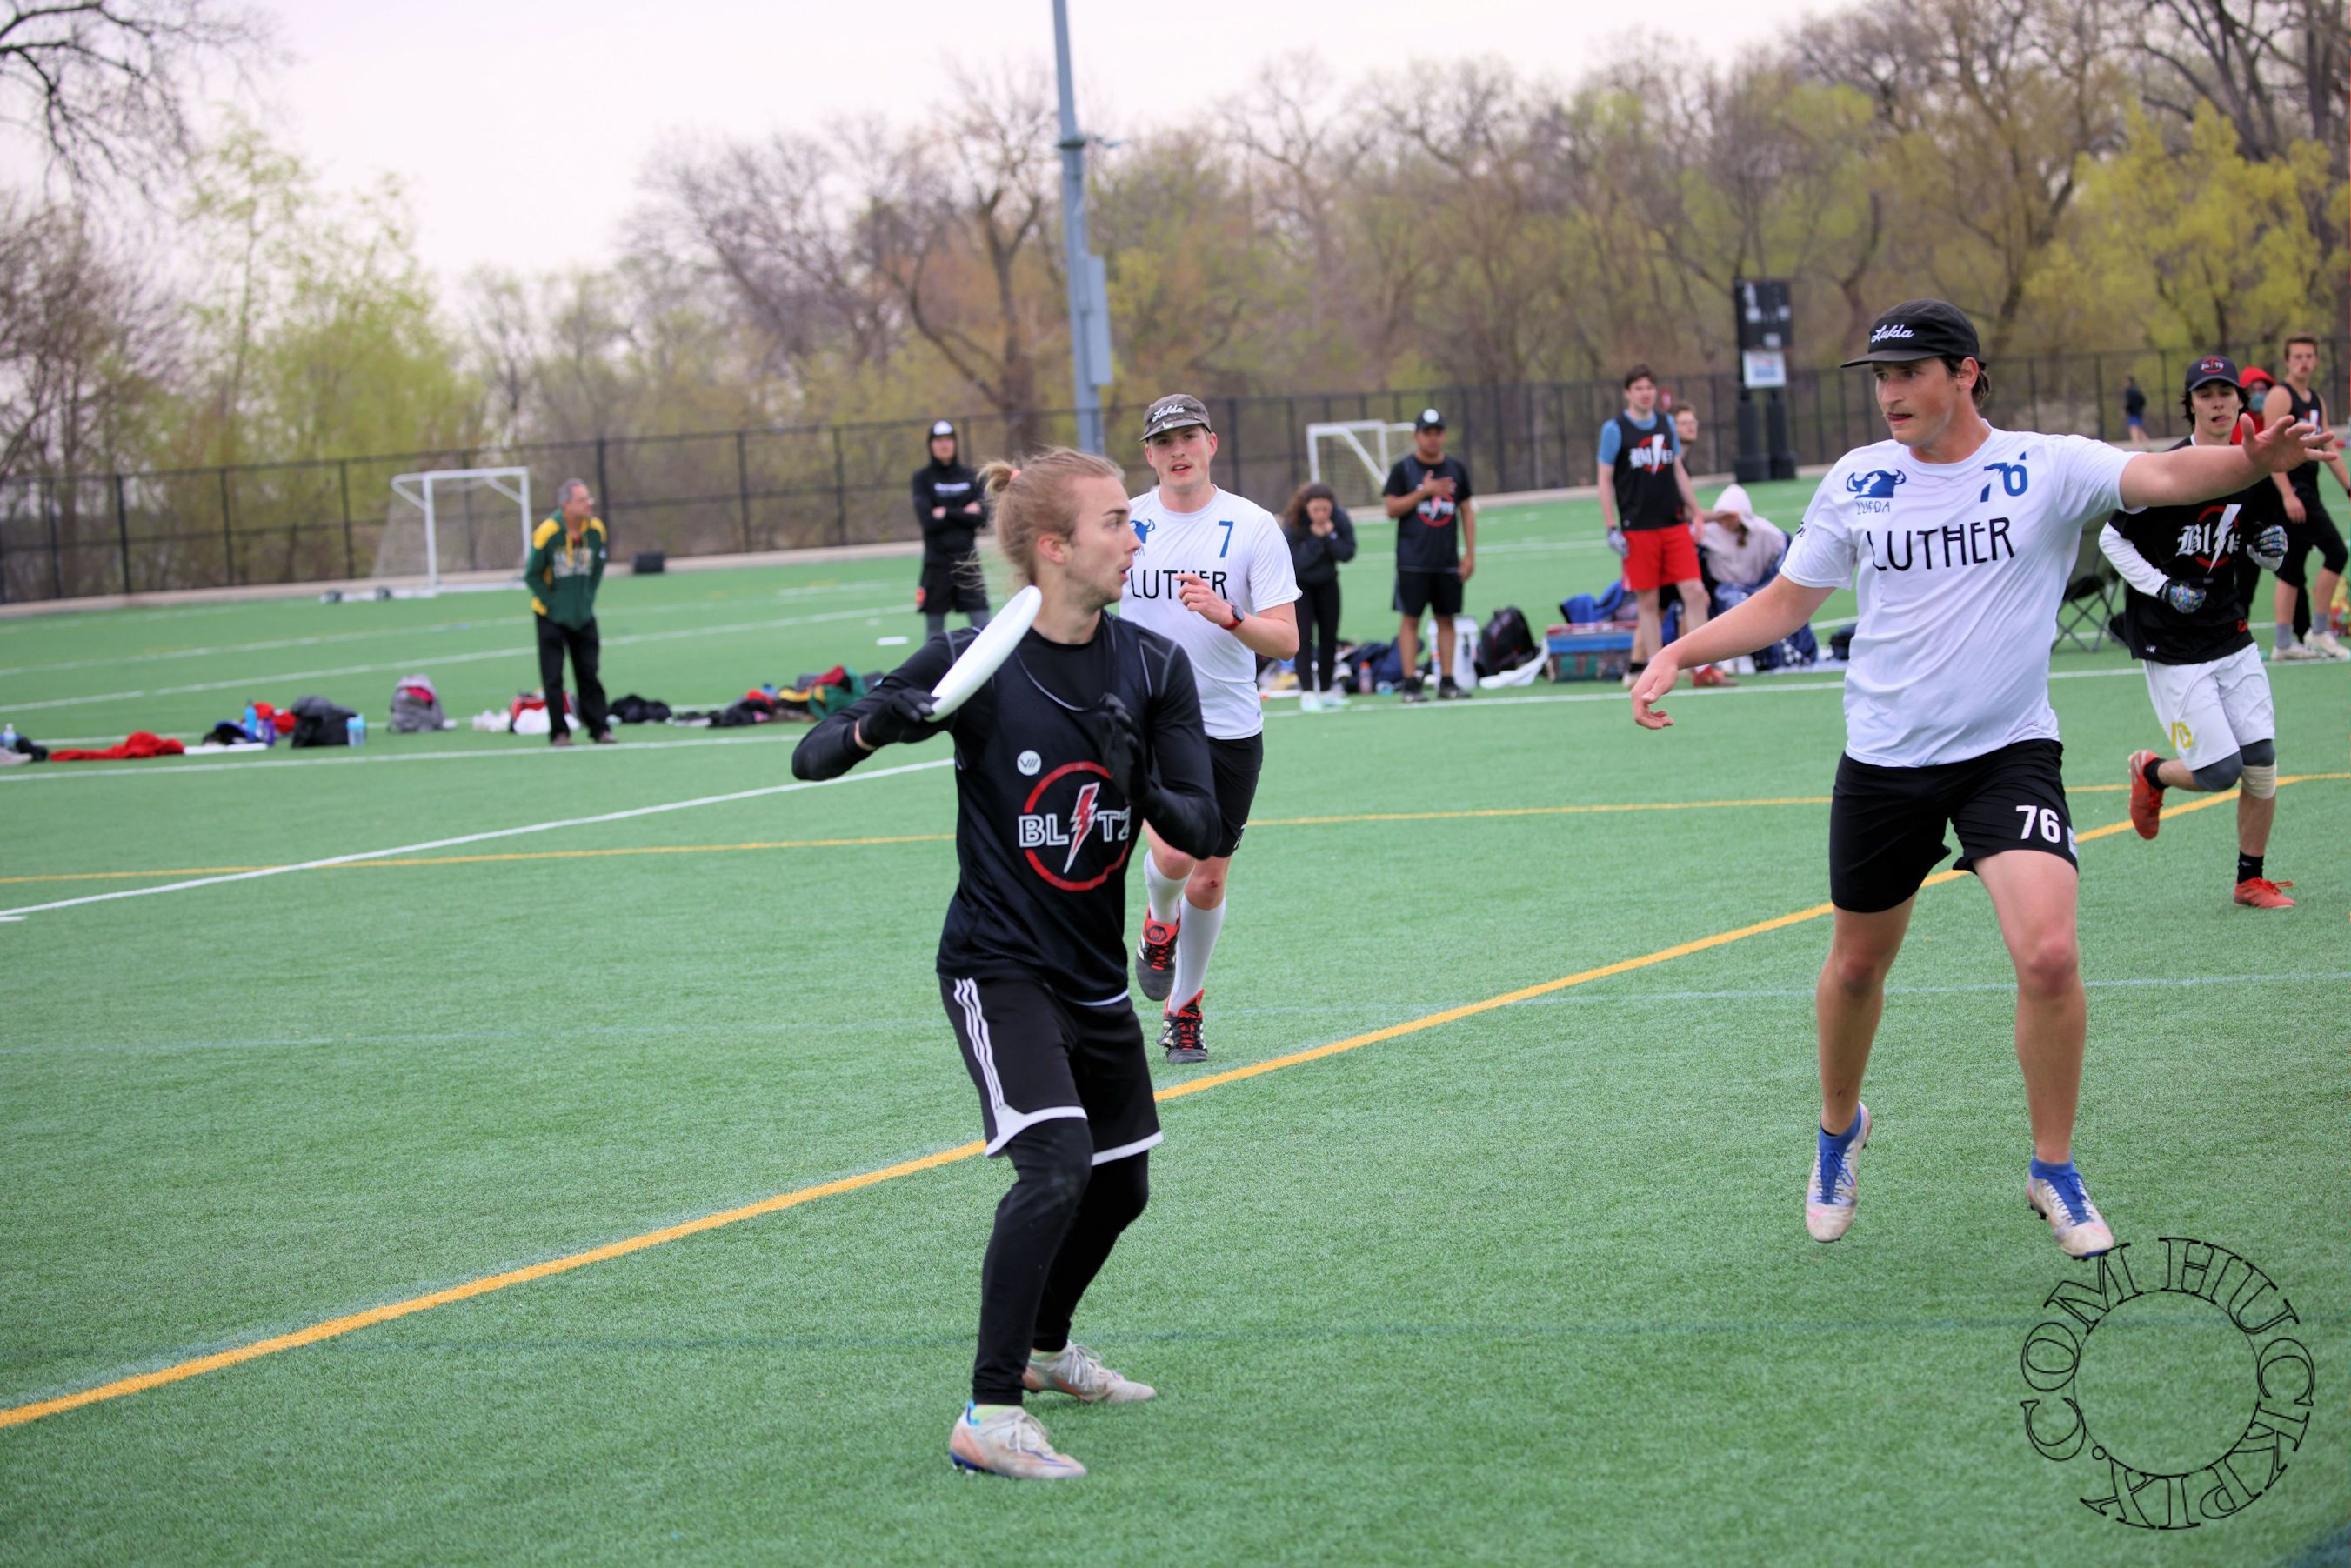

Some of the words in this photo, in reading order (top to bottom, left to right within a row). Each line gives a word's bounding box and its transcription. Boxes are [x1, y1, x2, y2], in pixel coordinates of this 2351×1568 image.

[1219, 520, 1234, 558] 7
[1867, 517, 2015, 571] LUTHER
[2015, 804, 2061, 844] 76
